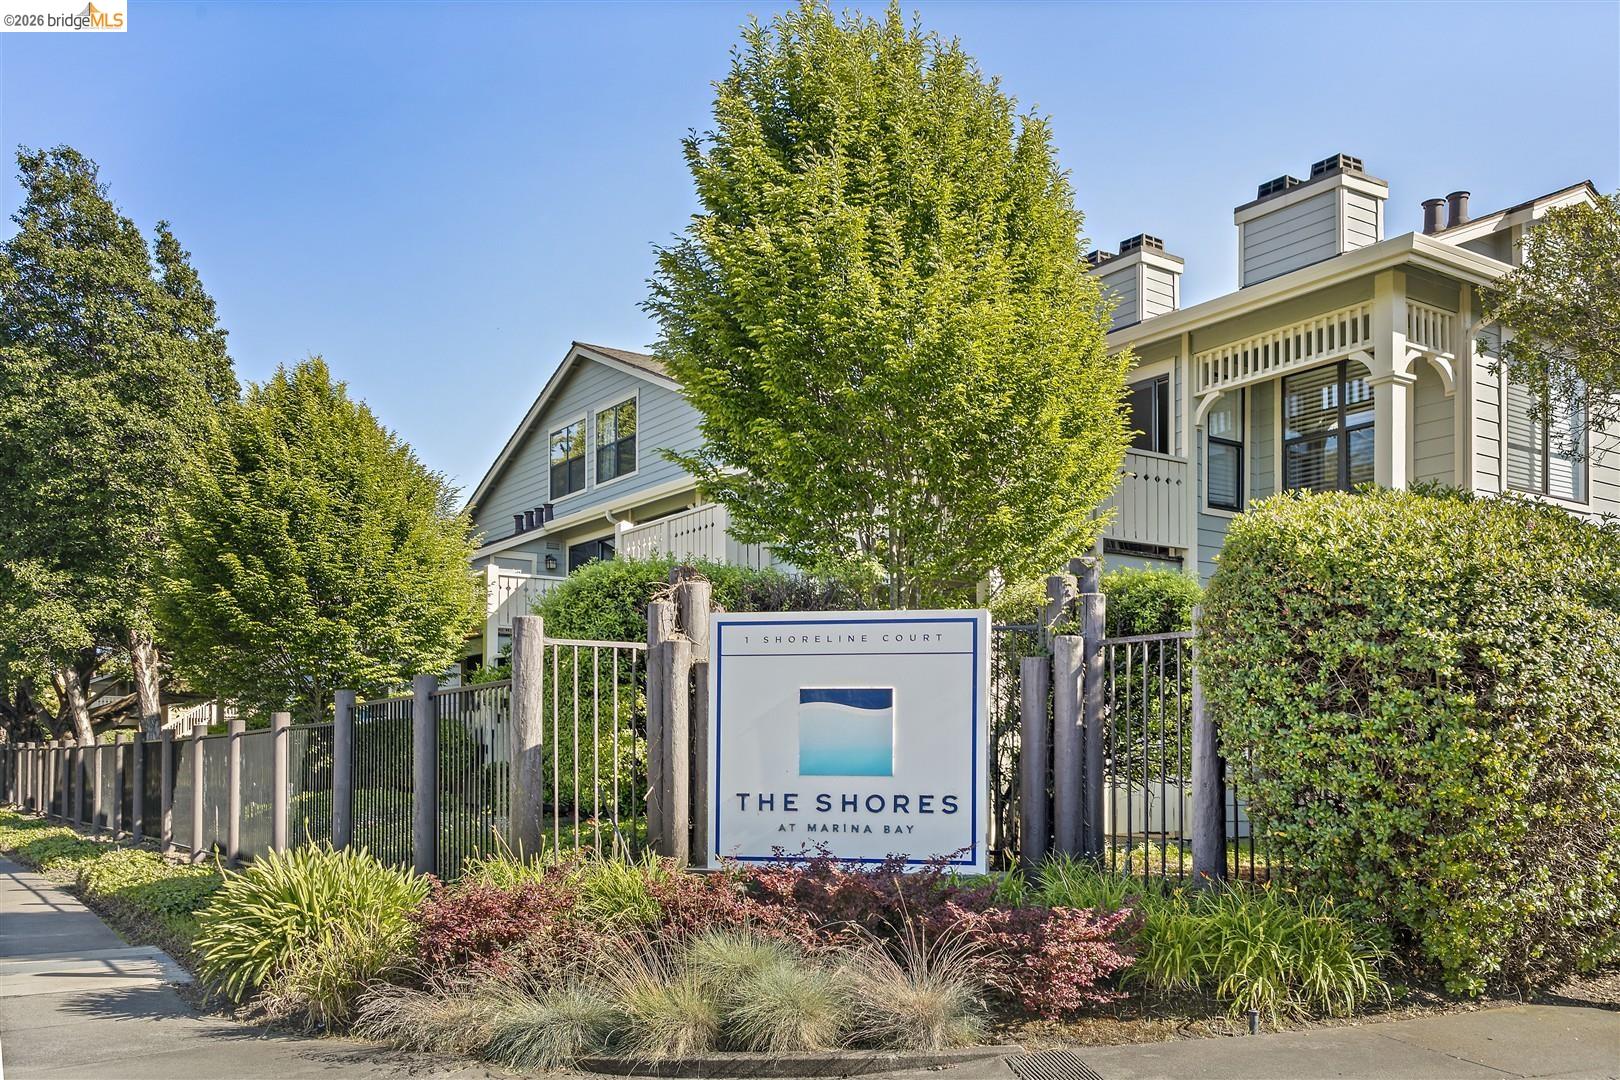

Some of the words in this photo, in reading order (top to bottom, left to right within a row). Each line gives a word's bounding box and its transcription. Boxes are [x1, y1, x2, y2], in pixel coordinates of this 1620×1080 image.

[744, 636, 749, 644] 1
[763, 634, 868, 644] SHORELINE
[882, 633, 943, 642] COURT
[736, 792, 799, 812] THE
[816, 793, 959, 815] SHORES
[778, 823, 796, 833] AT
[807, 823, 873, 834] MARINA
[883, 824, 915, 835] BAY
